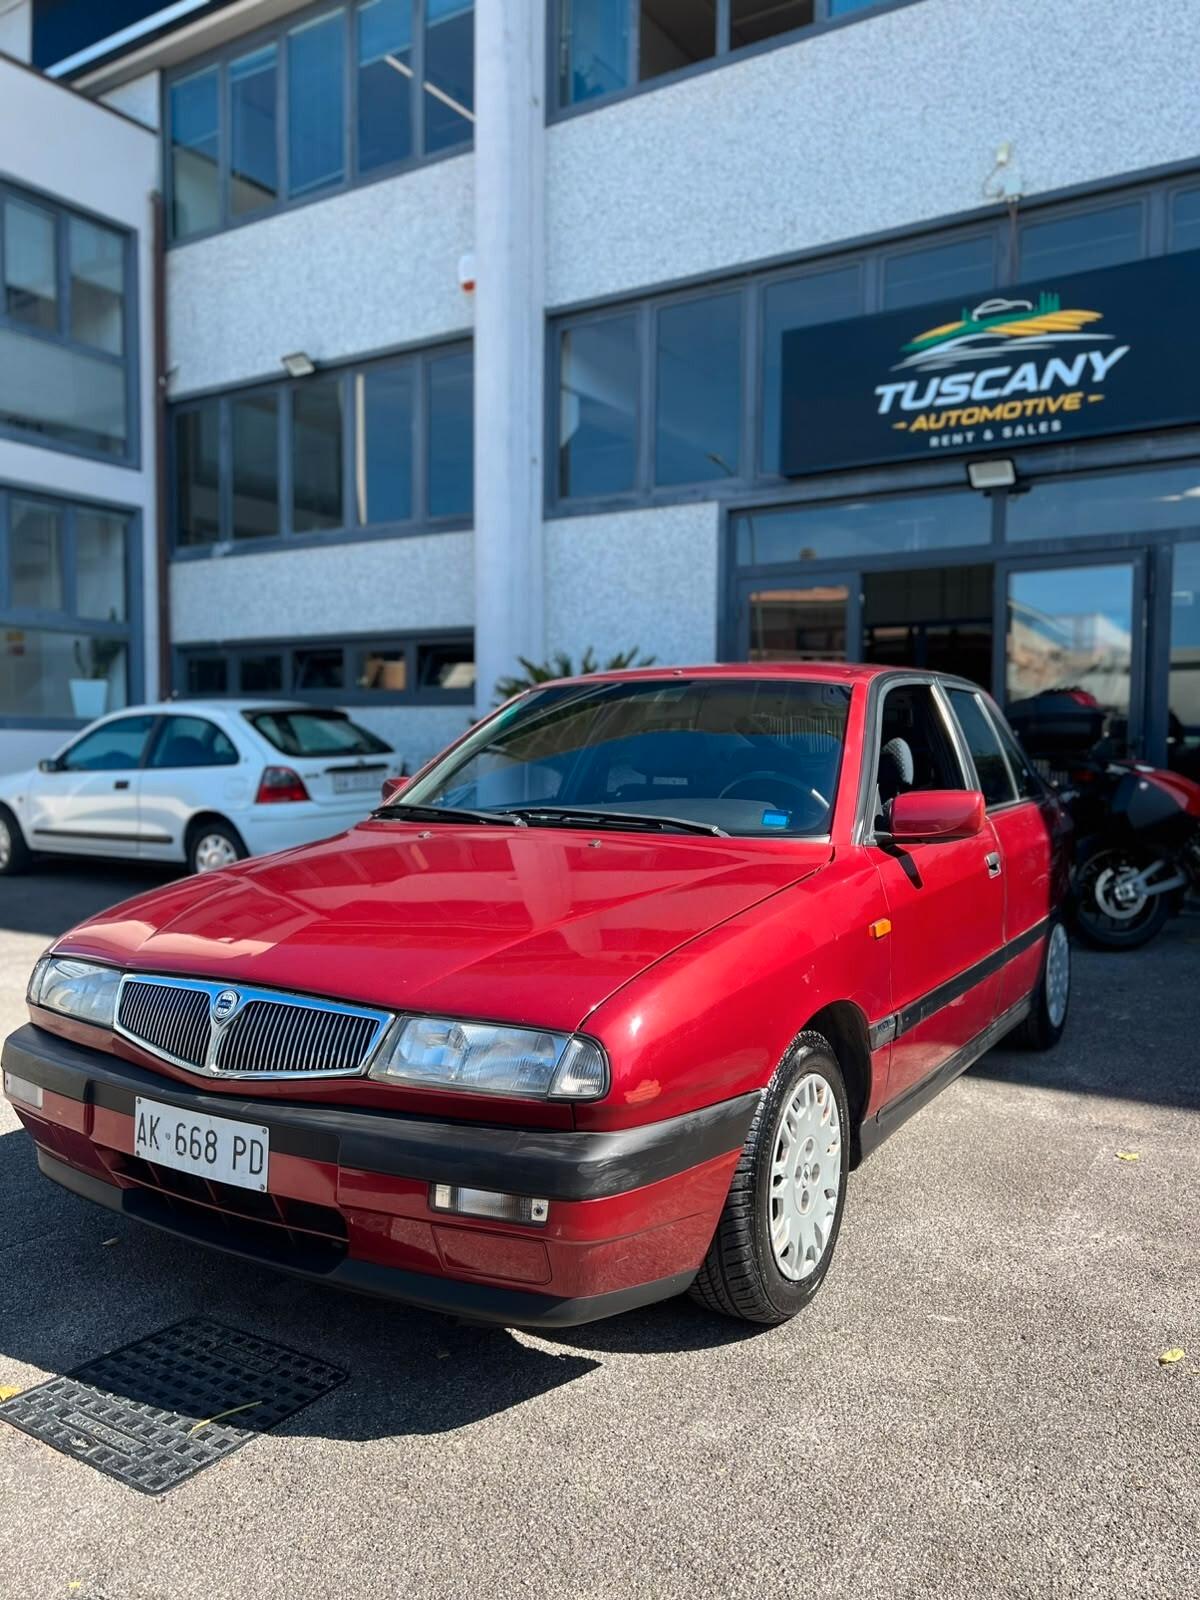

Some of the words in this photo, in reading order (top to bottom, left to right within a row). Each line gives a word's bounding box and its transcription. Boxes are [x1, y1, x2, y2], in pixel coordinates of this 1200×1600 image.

[875, 345, 1130, 414] TUSCANY
[909, 391, 1084, 432] AUTOMOTIVE
[929, 431, 975, 447] RENT
[983, 428, 994, 441] &
[1002, 419, 1062, 438] SALES
[136, 1112, 160, 1150] AK
[175, 1123, 218, 1164] 668
[232, 1135, 264, 1175] PD
